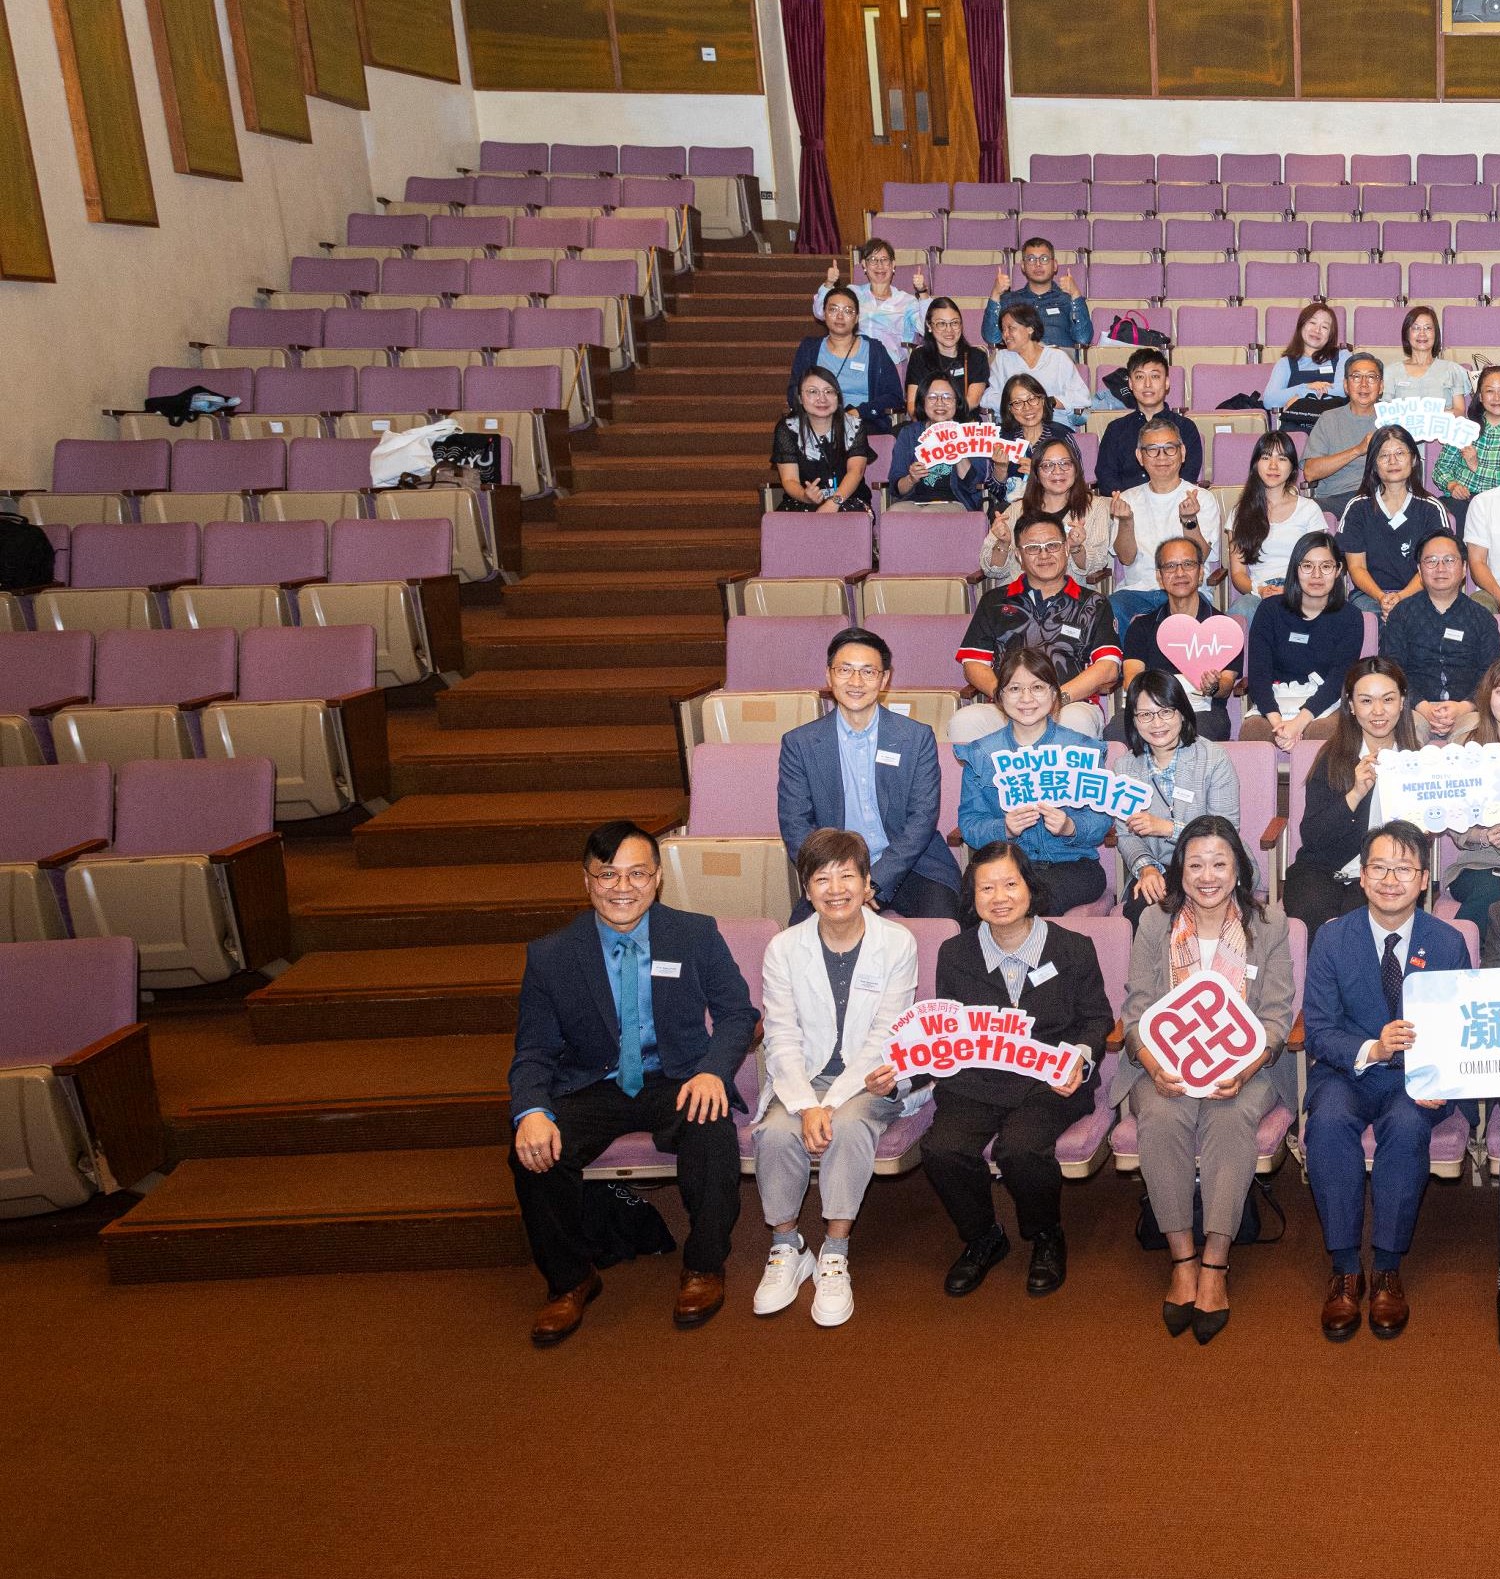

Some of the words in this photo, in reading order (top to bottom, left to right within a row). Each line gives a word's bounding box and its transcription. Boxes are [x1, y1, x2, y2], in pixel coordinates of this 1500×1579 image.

[1378, 400, 1417, 417] PolyU
[1423, 400, 1441, 413] SN
[936, 430, 958, 442] We
[963, 425, 997, 437] Walk
[920, 438, 1024, 464] together!
[997, 751, 1057, 773] PolyU
[1066, 751, 1094, 770] SN
[1000, 770, 1147, 816] 凝聚同行
[1402, 780, 1442, 792] MENTAL
[1445, 777, 1482, 789] HEALTH
[1416, 788, 1467, 801] SERVICES
[917, 1001, 960, 1015] 凝聚同行
[892, 1010, 915, 1032] PolyU
[920, 1014, 959, 1037] We
[968, 1011, 1028, 1036] Walk
[890, 1035, 1072, 1080] together!
